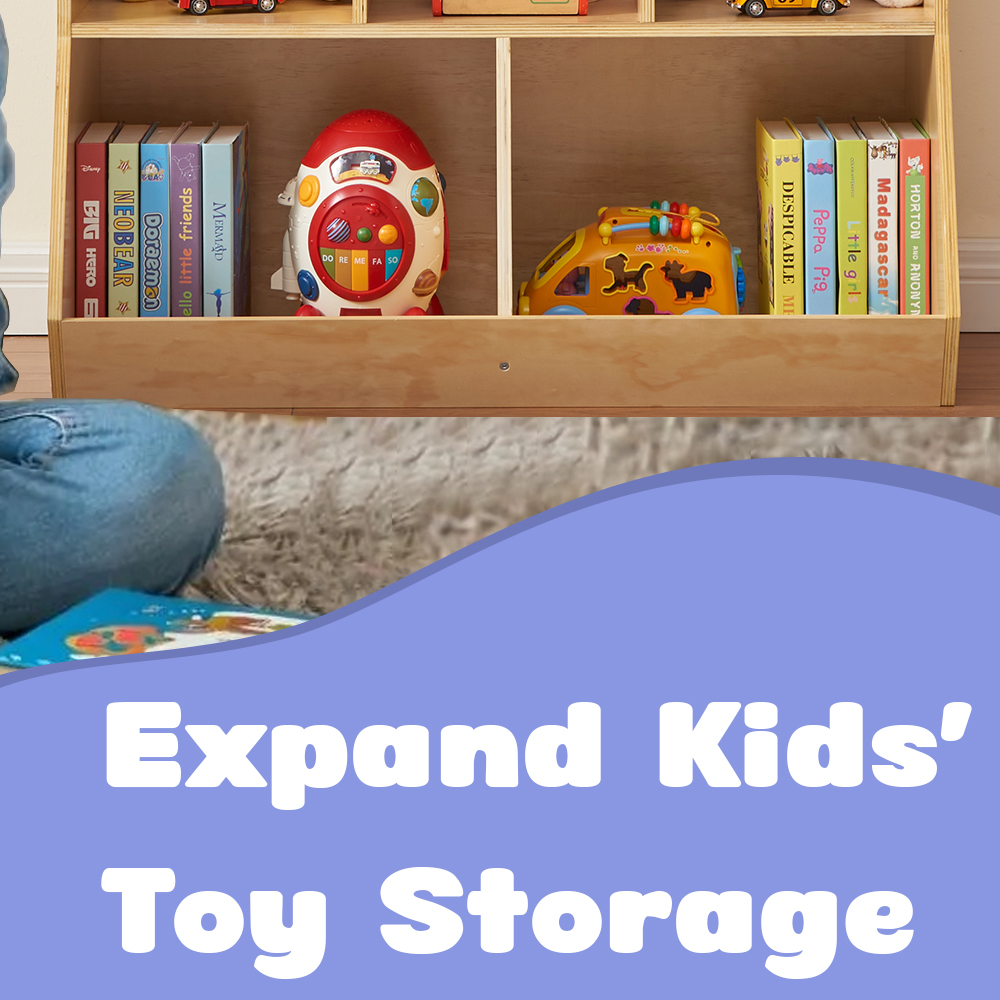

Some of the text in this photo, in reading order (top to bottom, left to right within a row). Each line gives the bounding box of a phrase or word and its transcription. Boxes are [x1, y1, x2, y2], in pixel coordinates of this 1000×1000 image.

[80, 164, 102, 174] Disney
[83, 200, 100, 240] BIG
[113, 190, 135, 287] NEOBEAR
[178, 187, 194, 241] friends
[781, 181, 795, 285] DESPICABLE
[874, 177, 892, 298] Madagascar
[909, 184, 921, 240] HORTON
[85, 247, 97, 287] HERO
[142, 212, 164, 311] Doraemon
[178, 248, 193, 284] little
[322, 254, 399, 265] DO RE ME FA SO
[811, 209, 831, 294] Peppa Pig
[843, 220, 862, 304] Little girls
